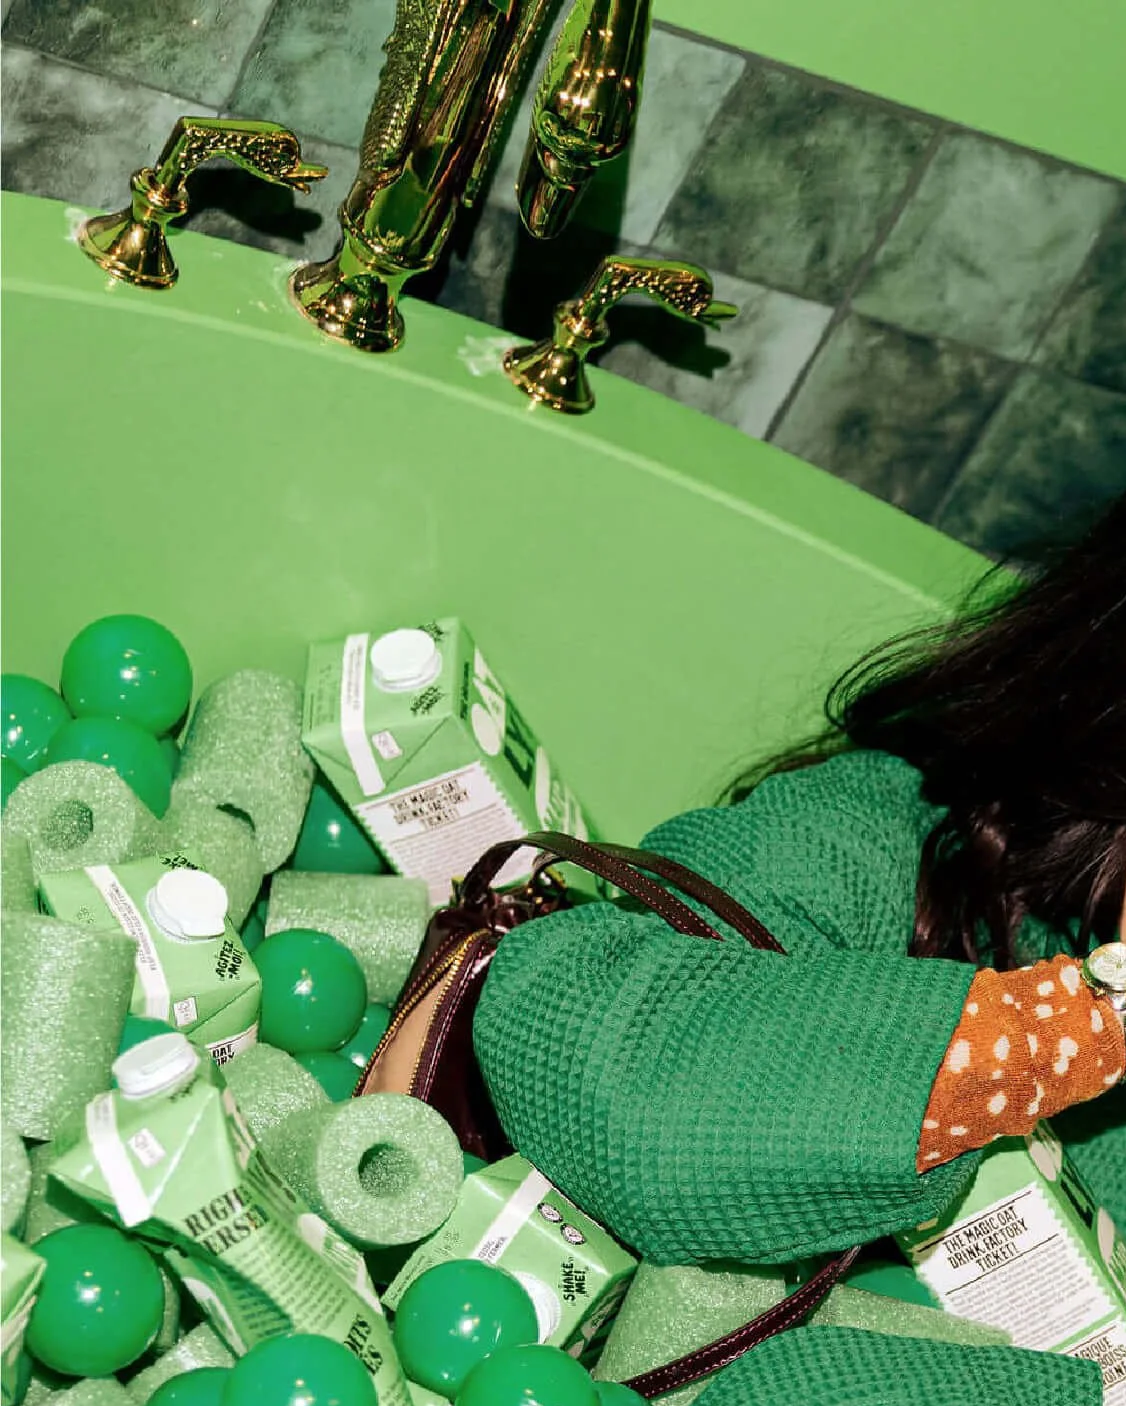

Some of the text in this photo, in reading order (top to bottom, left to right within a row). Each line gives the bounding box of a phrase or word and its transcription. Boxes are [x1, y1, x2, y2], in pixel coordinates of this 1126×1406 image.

[215, 940, 233, 978] AGITEZ
[942, 1205, 1019, 1254] THE MAGIC OAT
[982, 1217, 1028, 1251] FACTORY
[976, 1241, 1020, 1272] TICKET!
[562, 1262, 576, 1301] SHAKE
[574, 1270, 586, 1295] ME!
